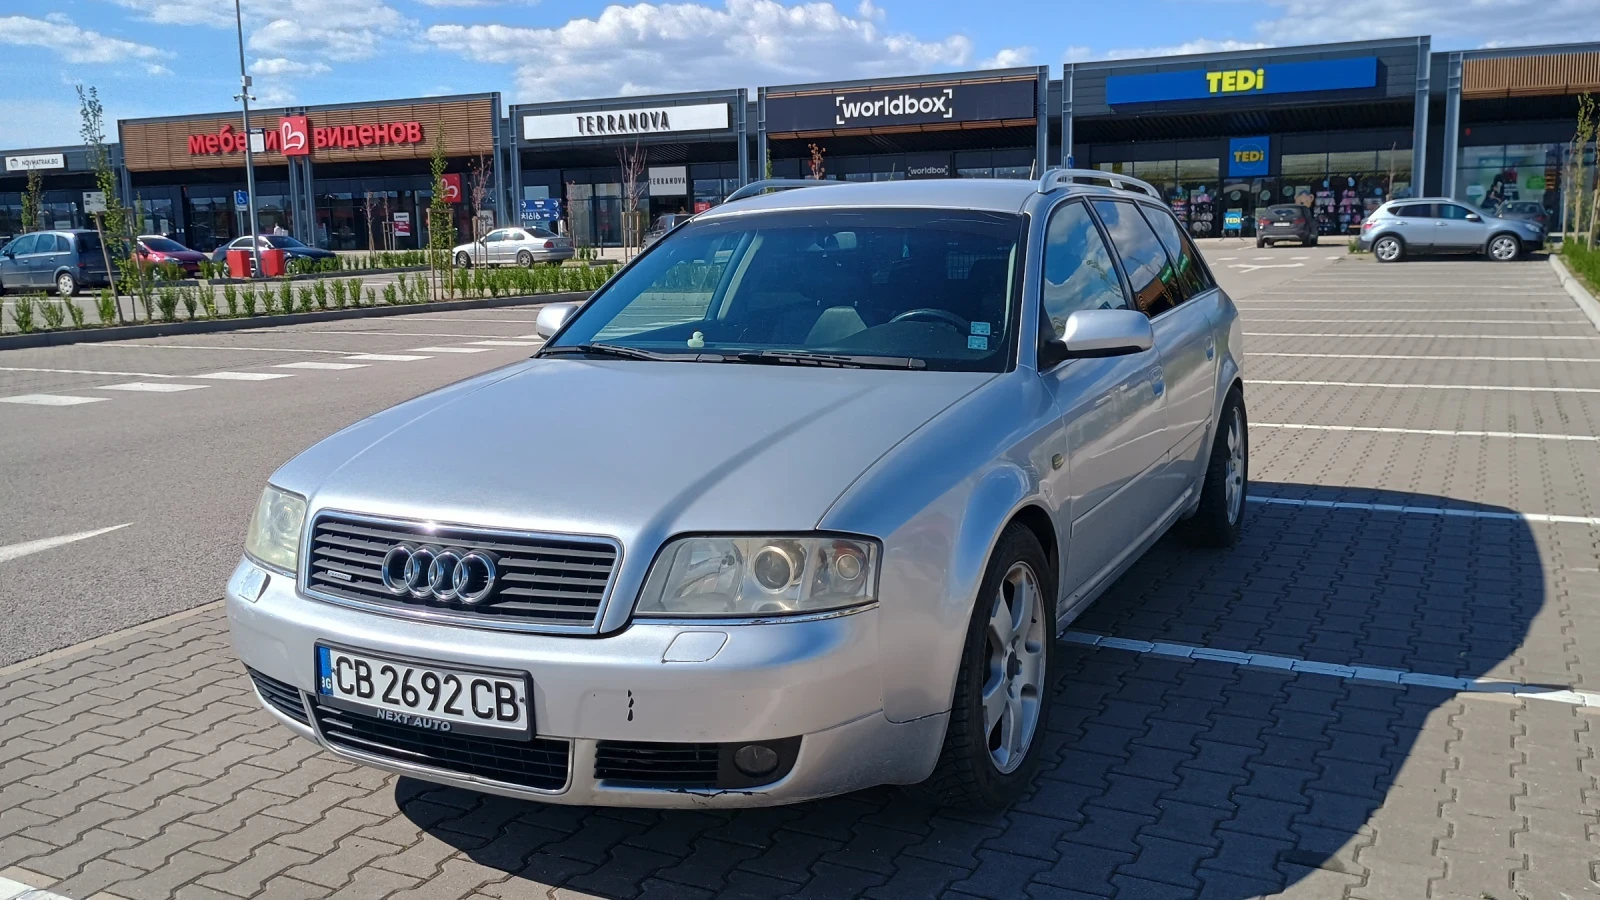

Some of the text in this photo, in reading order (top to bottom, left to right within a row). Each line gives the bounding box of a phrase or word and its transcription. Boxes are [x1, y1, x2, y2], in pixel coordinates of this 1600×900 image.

[1206, 68, 1264, 93] TEDi
[842, 95, 946, 118] worldbox
[577, 111, 670, 135] TERRANOVA
[188, 121, 422, 154] мебеи виденов
[1233, 150, 1264, 163] TEDi
[649, 177, 686, 185] TERRANOVA
[910, 166, 946, 175] worldbox
[380, 665, 464, 717] 2692
[376, 709, 451, 732] NEXT AUTO
